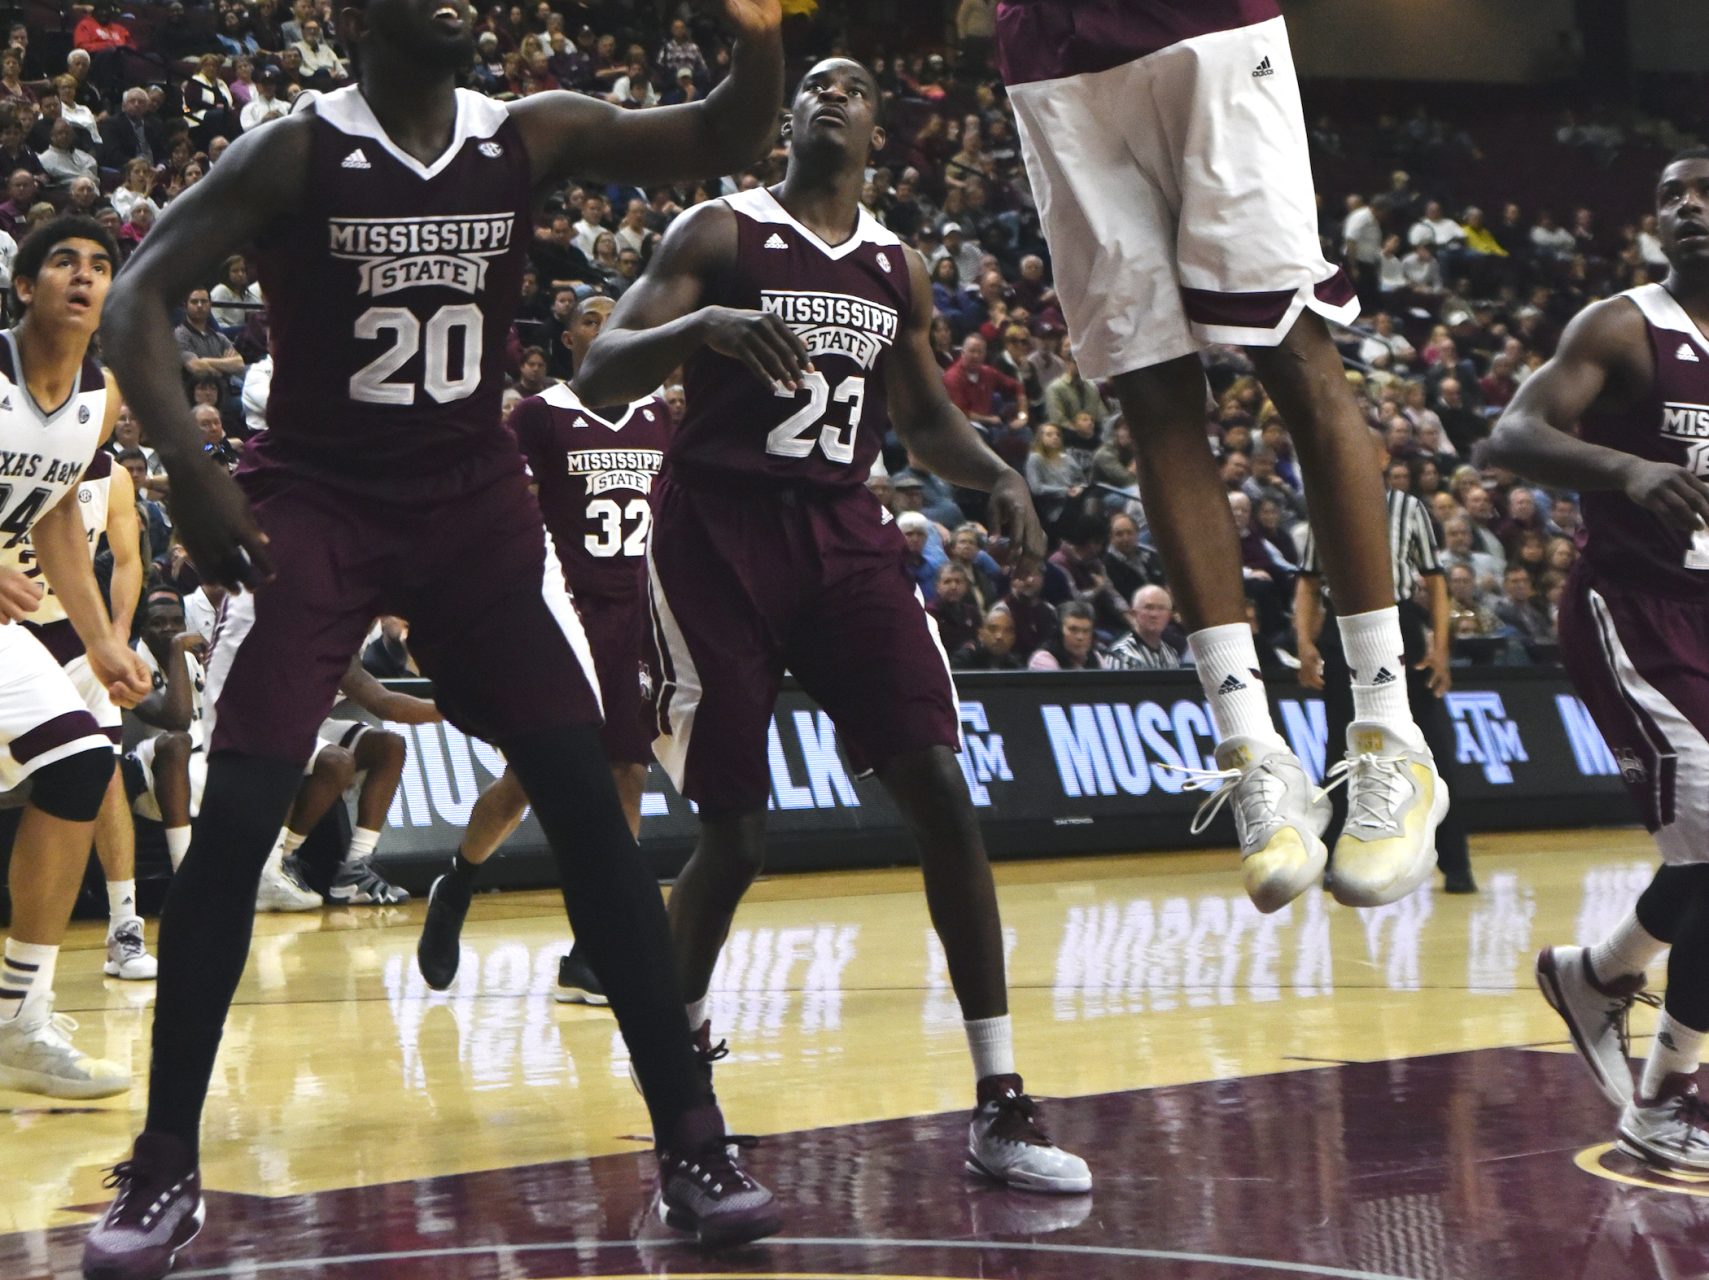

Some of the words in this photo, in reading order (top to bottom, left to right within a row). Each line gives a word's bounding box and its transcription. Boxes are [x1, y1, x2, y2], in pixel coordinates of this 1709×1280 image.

[330, 220, 515, 253] MISSISSIPPI
[382, 261, 468, 289] STATE
[761, 295, 898, 340] MISSISSIPPI
[350, 303, 484, 405] 20
[807, 330, 868, 360] STATE
[765, 371, 865, 464] 23
[0, 449, 42, 478] XAS
[567, 453, 664, 472] MISSISSIPPI
[599, 473, 644, 490] STATE
[584, 499, 651, 558] 32
[1042, 698, 1224, 798] MUSC
